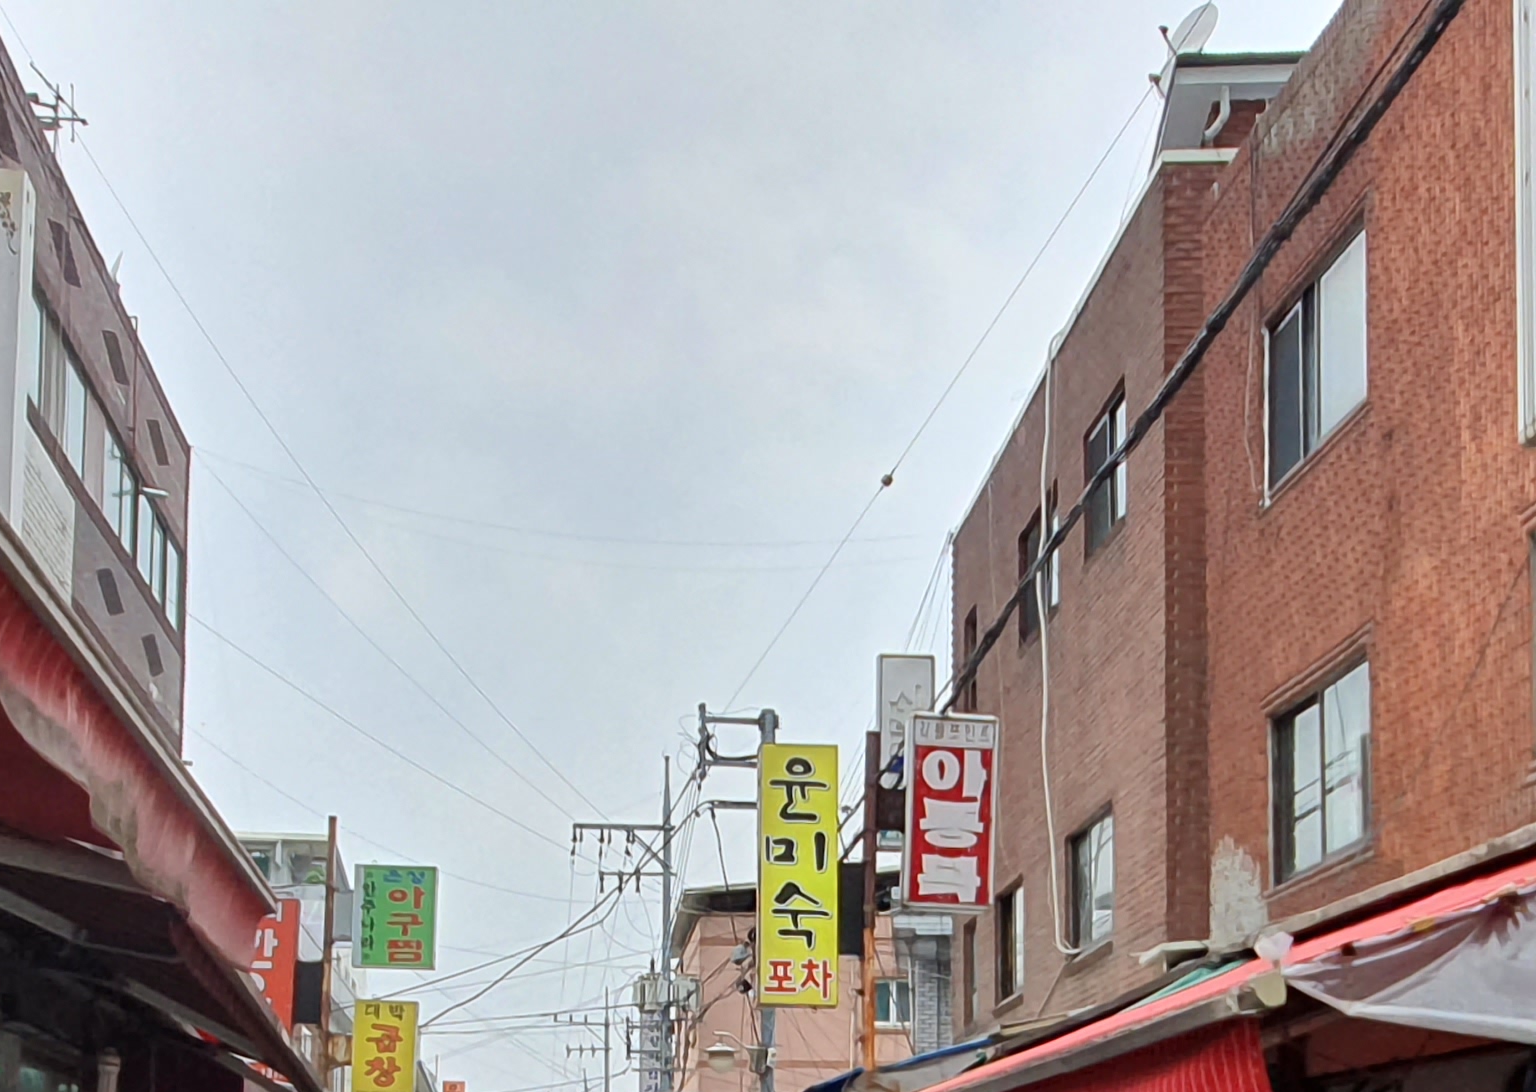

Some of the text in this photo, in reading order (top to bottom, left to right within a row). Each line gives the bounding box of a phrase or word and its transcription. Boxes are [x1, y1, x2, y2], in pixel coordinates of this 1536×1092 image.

[765, 756, 830, 950] 윤미숙
[917, 748, 988, 904] 아동복
[386, 885, 426, 963] 아구찜
[364, 1003, 406, 1021] 대박
[763, 957, 834, 1001] 포차
